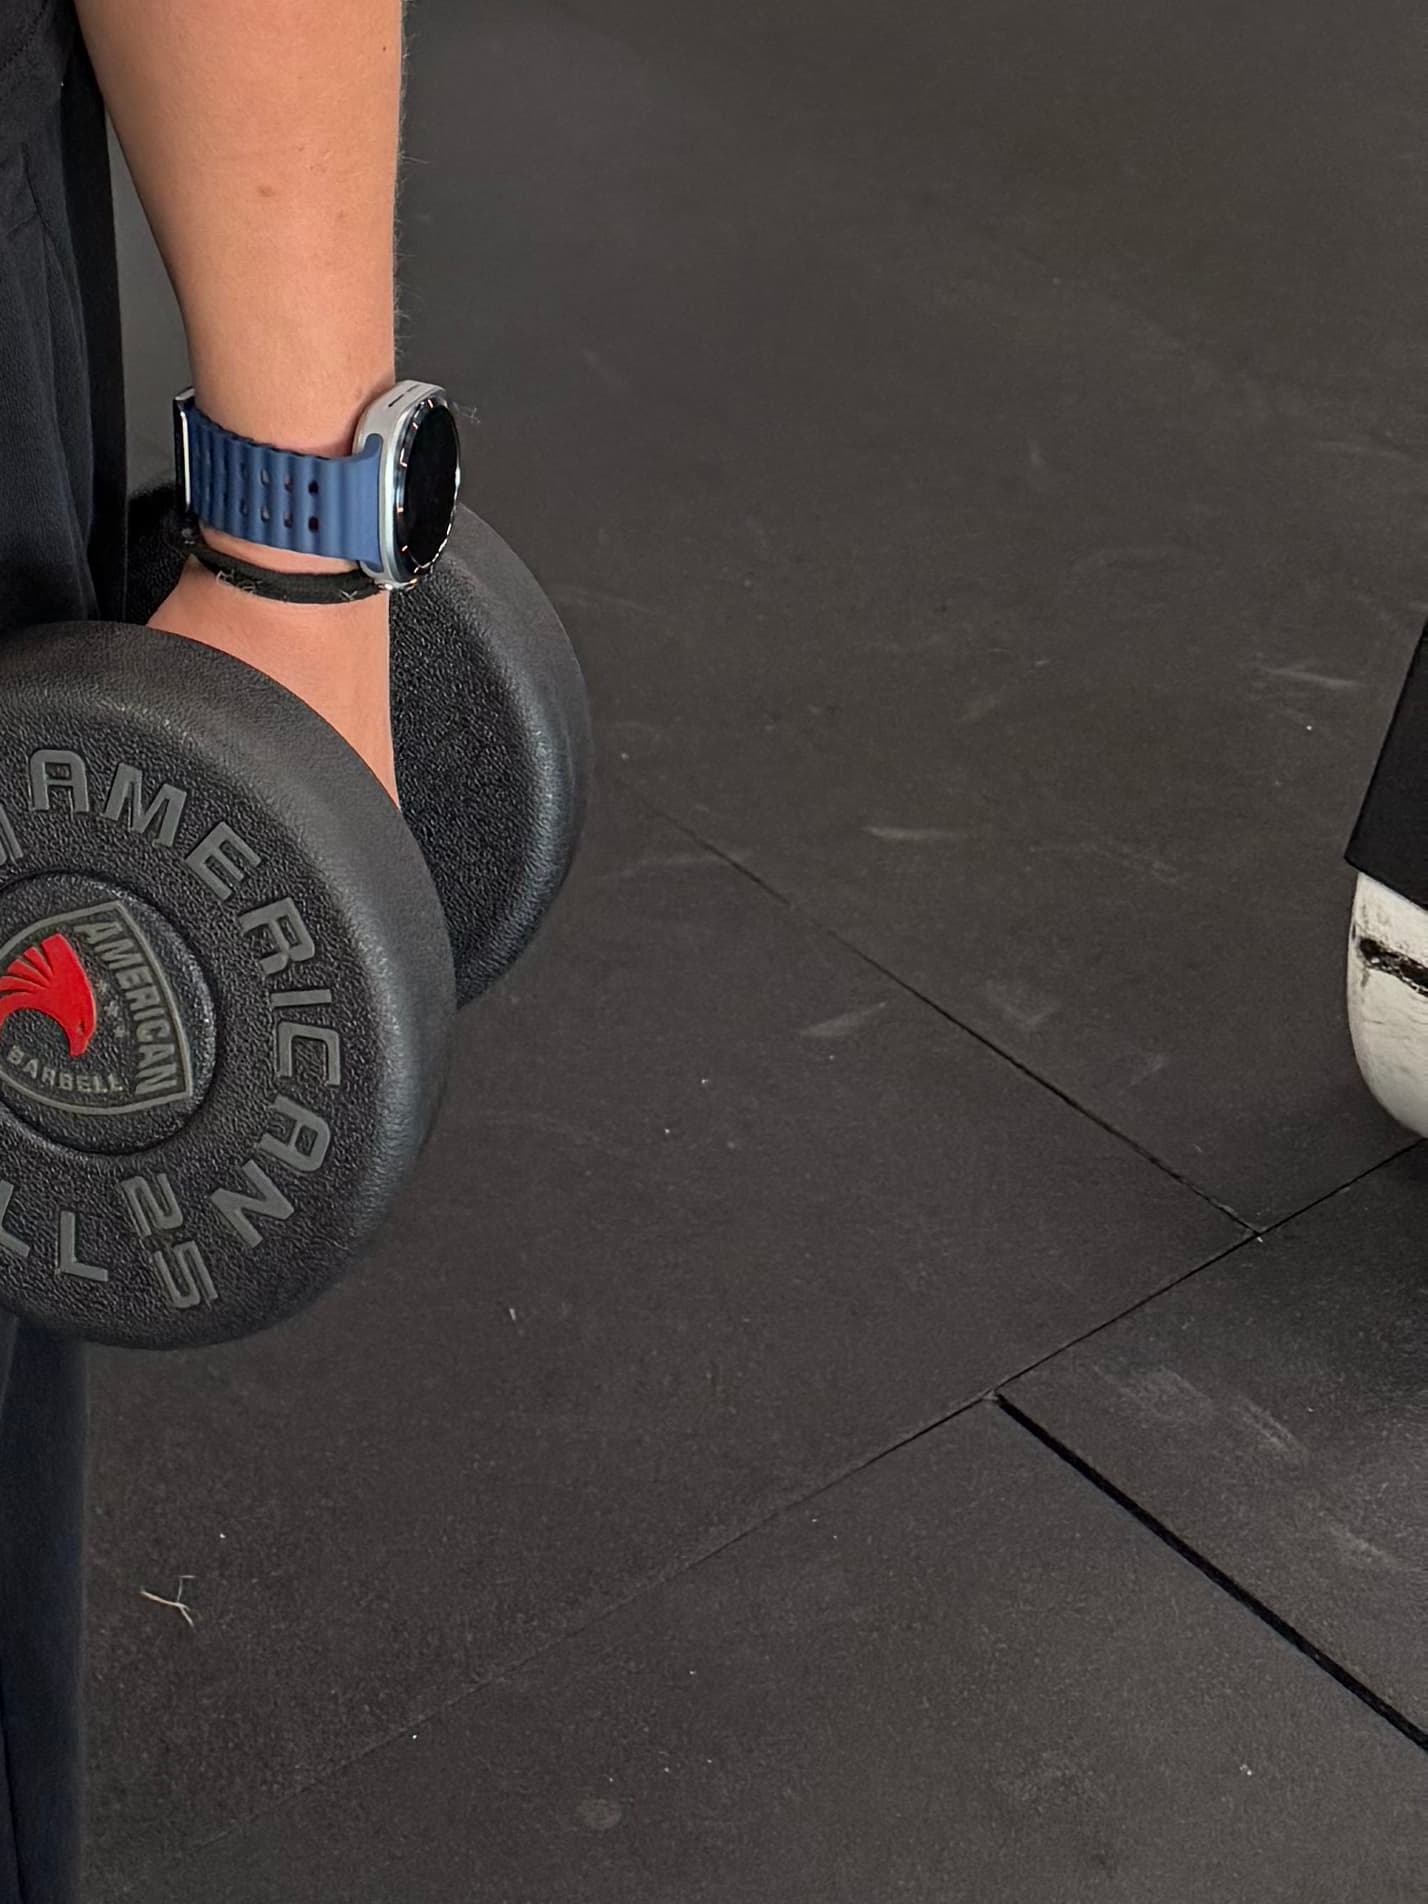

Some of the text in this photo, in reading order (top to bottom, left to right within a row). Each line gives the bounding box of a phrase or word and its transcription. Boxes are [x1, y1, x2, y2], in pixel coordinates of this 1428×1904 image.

[6, 1045, 125, 1094] BARBELL
[26, 747, 343, 1250] AMERICAN
[73, 920, 178, 1096] AMERICAN
[118, 1171, 221, 1311] 25
